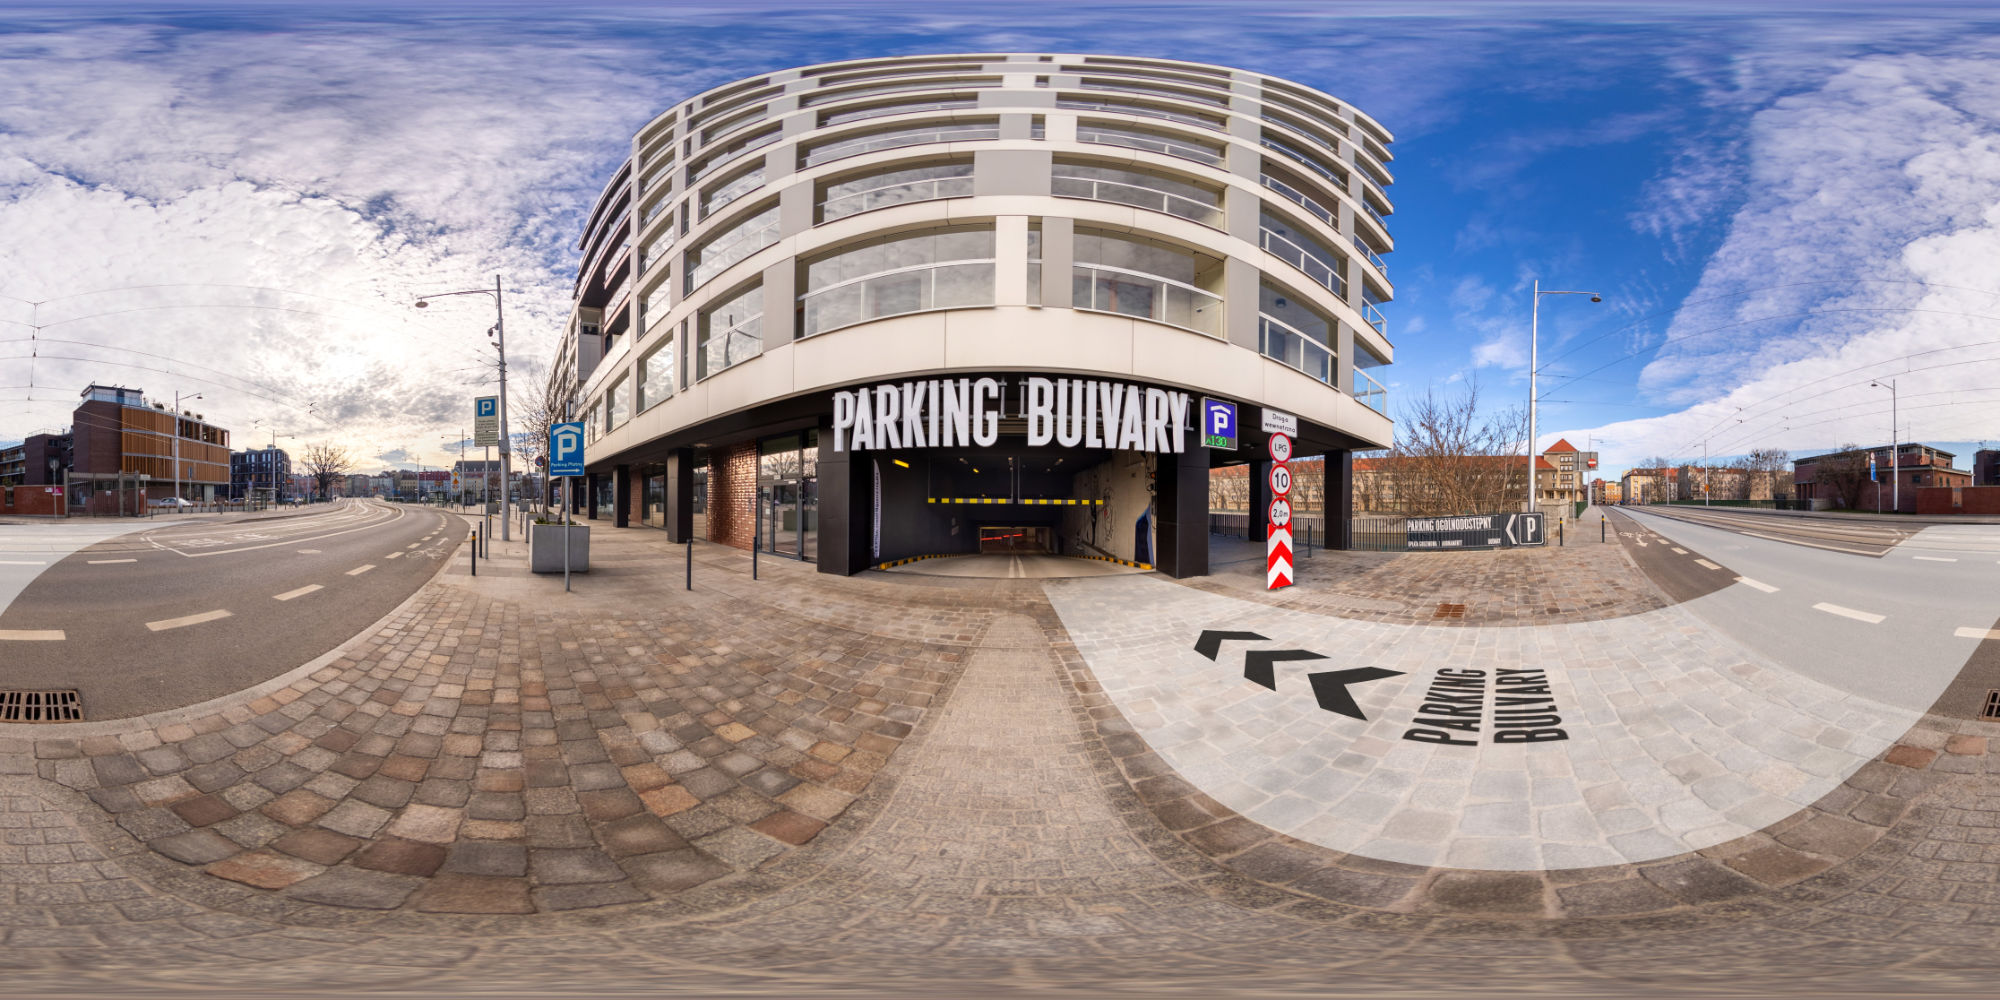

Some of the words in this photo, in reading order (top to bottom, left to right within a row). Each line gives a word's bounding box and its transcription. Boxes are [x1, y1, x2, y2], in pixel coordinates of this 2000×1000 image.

[482, 401, 492, 415] P
[833, 377, 999, 452] PARKING
[1028, 377, 1190, 453] BULVARY
[1214, 411, 1228, 434] P
[1272, 413, 1289, 423] Droga
[558, 434, 577, 461] P
[1274, 443, 1288, 453] LPG
[1274, 472, 1288, 488] 10
[1407, 519, 1434, 532] PARKING
[1526, 517, 1536, 542] P
